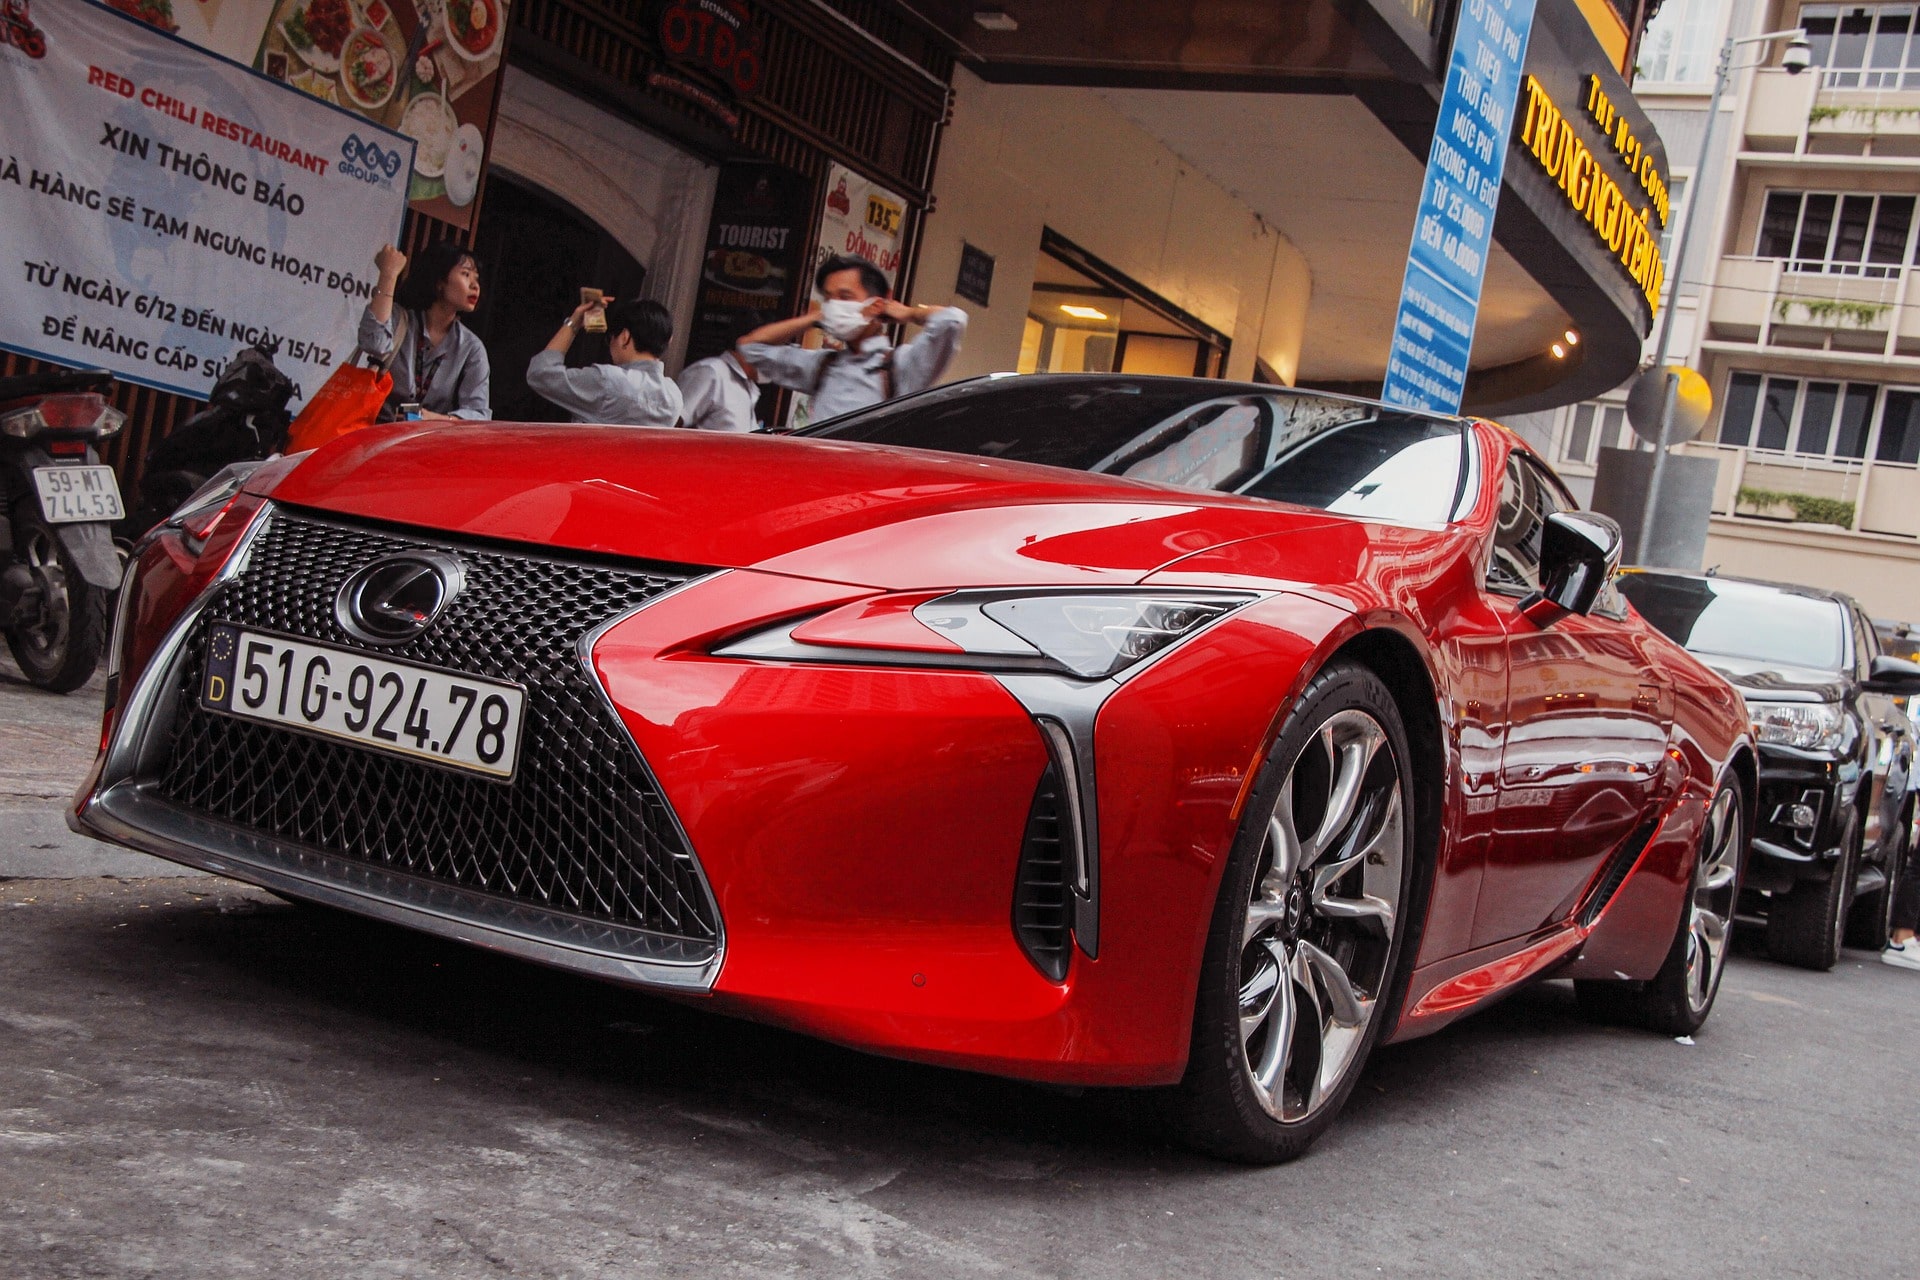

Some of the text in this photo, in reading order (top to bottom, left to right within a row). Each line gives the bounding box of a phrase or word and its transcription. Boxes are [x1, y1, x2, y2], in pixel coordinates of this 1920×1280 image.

[1476, 40, 1501, 85] THEO
[1484, 5, 1504, 44] THU
[1502, 26, 1523, 63] PHÍ
[87, 65, 330, 176] RED CHILI RESTAURANT
[1588, 73, 1616, 135] THE
[344, 138, 398, 174] 365
[1452, 107, 1496, 165] MỨC PHÍ
[99, 121, 304, 216] XIN THÔNG BÁO
[338, 160, 380, 185] GROUP
[1432, 176, 1449, 210] TỪ
[1433, 135, 1467, 184] TRONG
[1466, 166, 1480, 195] 01
[0, 155, 376, 299] À HÀNG SẼ TẠM NGƯNG HOẠT ĐỘN
[720, 225, 789, 249] TOURIST
[868, 201, 892, 231] 135
[24, 260, 332, 366] TỪ NGÀY 6/12 ĐẾN NGÀY 15/12
[42, 315, 78, 342] ĐỂ
[82, 327, 149, 360] NÂNG
[154, 345, 198, 371] CẤP
[46, 493, 118, 518] 744.53
[209, 676, 225, 702] D
[241, 640, 509, 765] 51G-924.78
